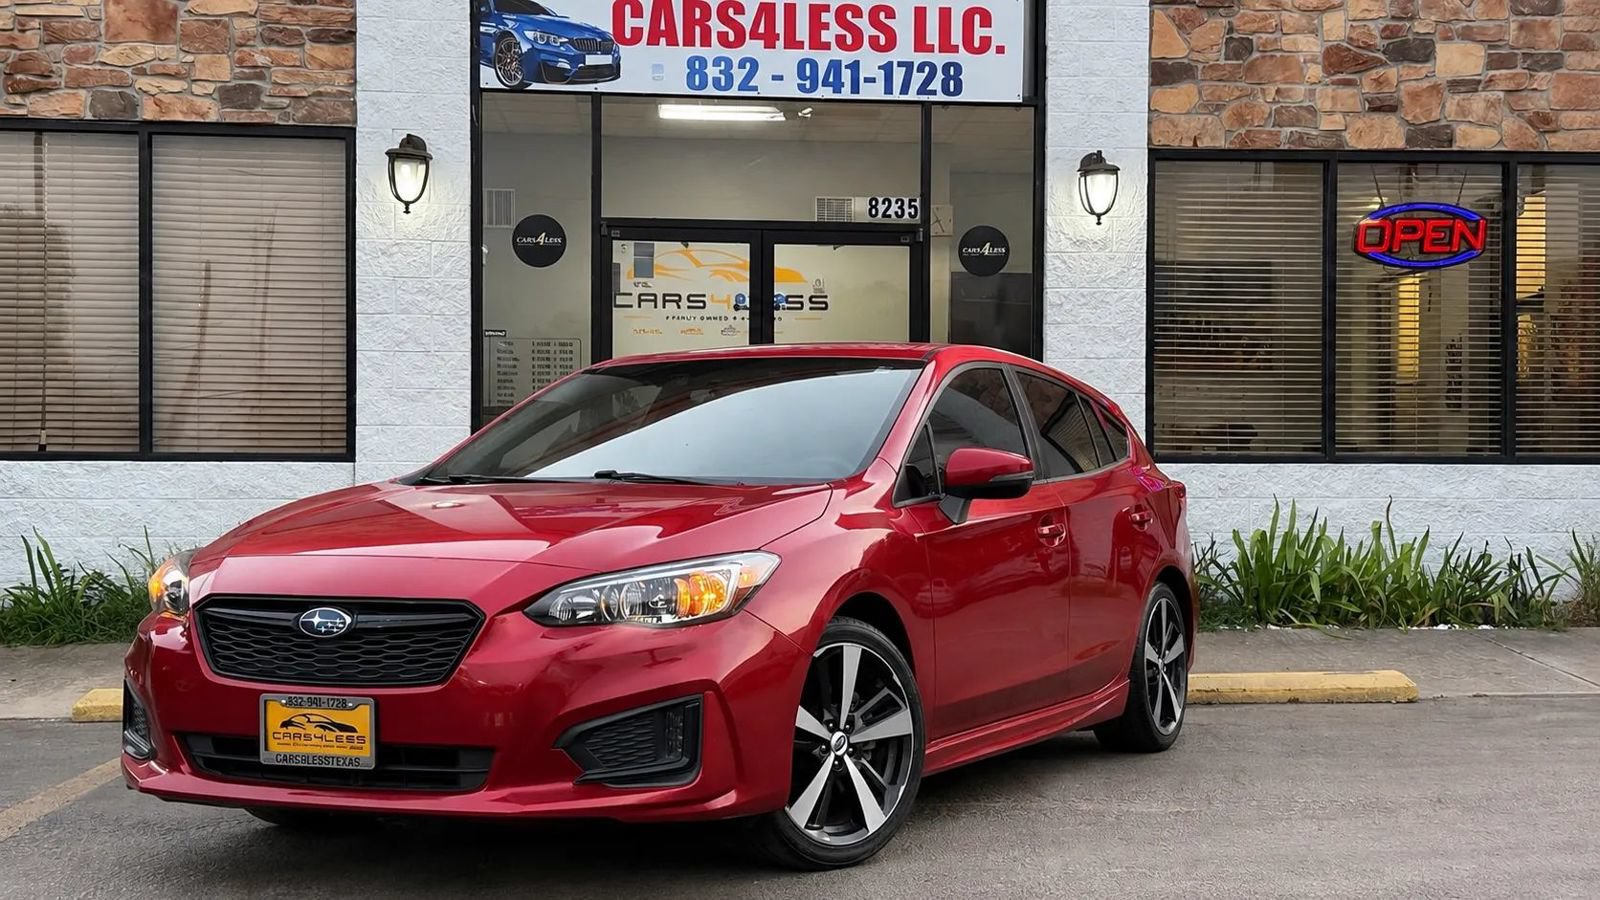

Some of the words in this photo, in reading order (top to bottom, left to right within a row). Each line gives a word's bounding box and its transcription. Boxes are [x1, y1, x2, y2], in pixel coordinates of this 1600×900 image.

[612, 0, 897, 53] CARS4LESS
[914, 6, 1006, 55] LLC.
[686, 55, 760, 92] 832
[796, 57, 963, 97] 941-1728
[868, 197, 919, 219] 8235
[1355, 216, 1487, 253] OPEN
[272, 731, 367, 745] CARS4LESS
